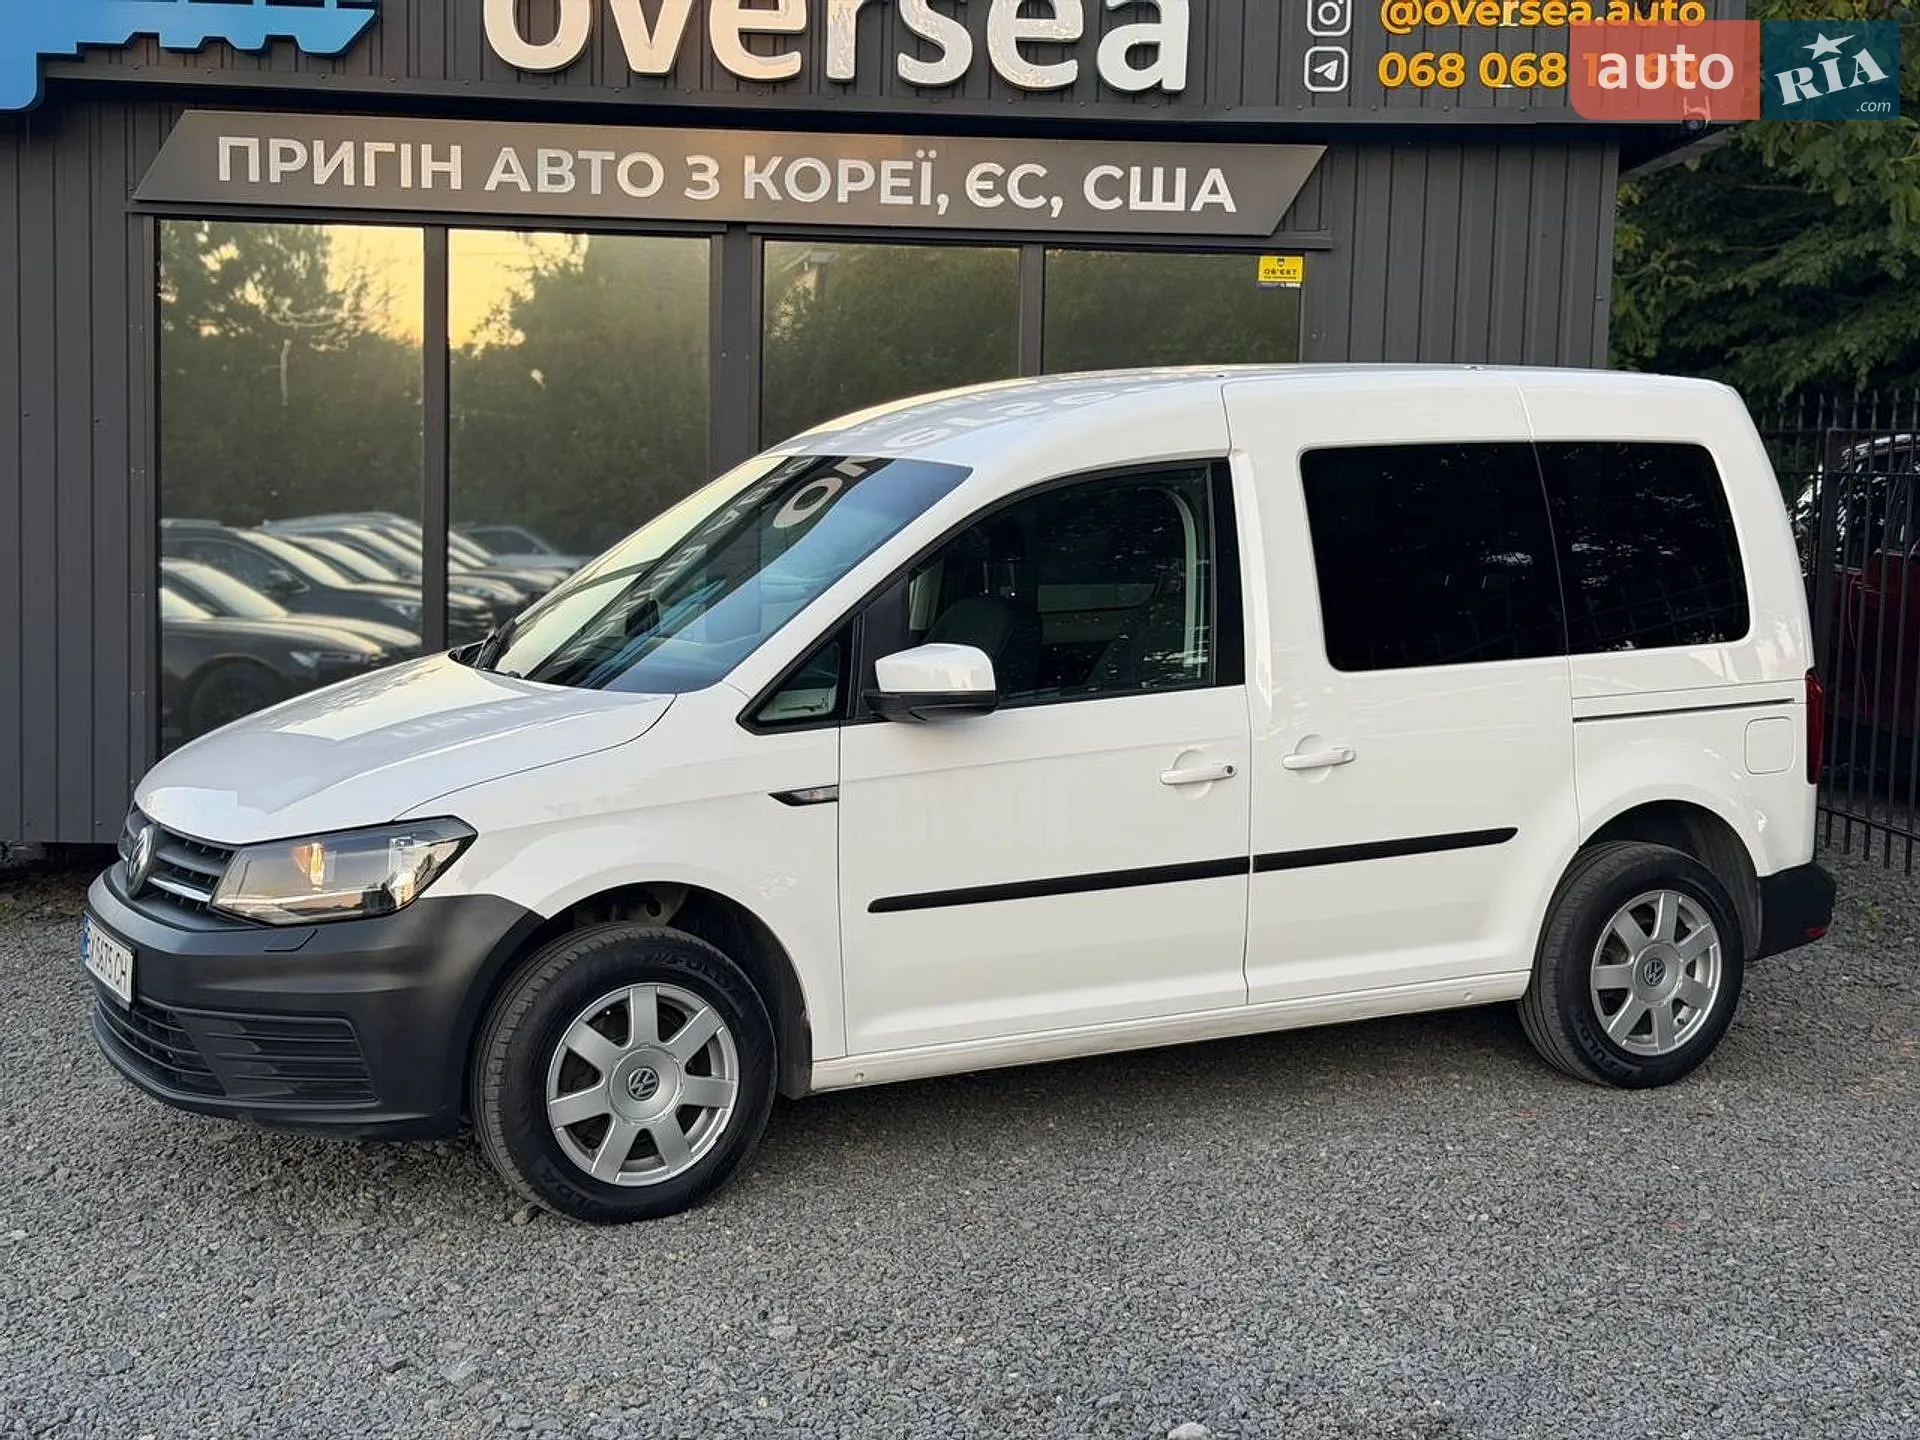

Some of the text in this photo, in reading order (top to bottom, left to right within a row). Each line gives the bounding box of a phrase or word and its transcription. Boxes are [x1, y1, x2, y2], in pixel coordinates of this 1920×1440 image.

[483, 0, 1190, 92] oversea
[1380, 0, 1706, 34] @oversea.auto
[1377, 51, 1466, 88] 068
[1478, 51, 1567, 88] 068
[217, 135, 463, 191] ПРИГІН
[483, 146, 666, 198] АВТО
[743, 148, 950, 216] КОРЕЇ,
[964, 161, 1064, 218] ЄС,
[1082, 164, 1238, 213] США
